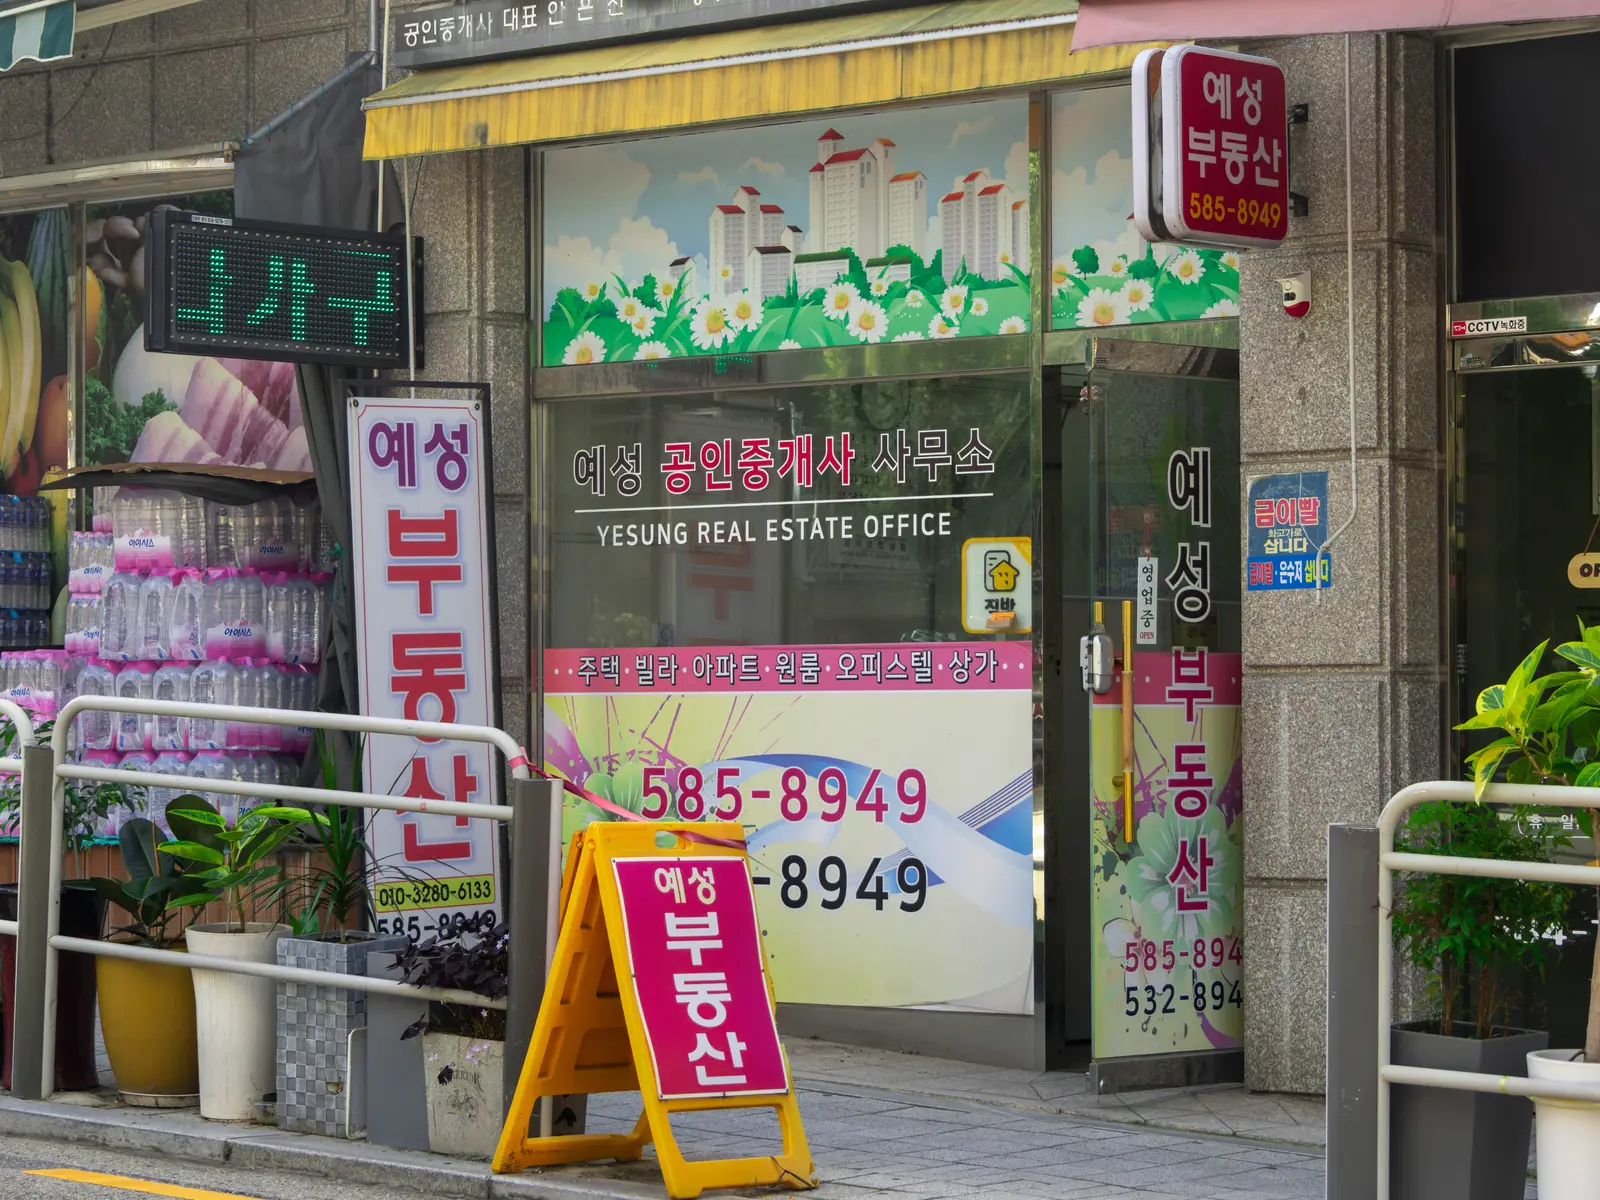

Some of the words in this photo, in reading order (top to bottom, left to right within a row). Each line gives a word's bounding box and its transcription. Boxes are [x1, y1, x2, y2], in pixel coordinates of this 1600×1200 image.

[404, 12, 493, 47] 공인중개사
[503, 5, 537, 31] 대표
[1203, 71, 1263, 126] 예성
[1188, 126, 1282, 188] 부동산
[1189, 192, 1281, 229] 585-8949
[368, 420, 469, 491] 예성
[573, 442, 642, 497] 예성
[660, 431, 856, 495] 공인중개사
[871, 427, 995, 484] 사무소
[597, 521, 688, 547] YESUNG
[698, 519, 757, 545] REAL
[766, 515, 853, 542] ESTATE
[863, 512, 951, 538] OFFICE
[1255, 497, 1320, 528] 금이빨
[1264, 537, 1308, 554] 삽니다
[1140, 564, 1155, 628] 영업중
[1140, 632, 1155, 640] OPEN
[387, 508, 478, 863] 부동산
[577, 654, 621, 686] 주택
[635, 653, 679, 686] 빌라
[692, 652, 761, 685] 아파트
[775, 651, 821, 685] 원룸
[835, 650, 933, 684] 오피스텔
[948, 649, 998, 683] 상가
[640, 766, 928, 824] 585-8949
[1164, 645, 1215, 914] 부동산
[379, 880, 492, 906] 010-3280-6133
[654, 867, 717, 905] 예성
[664, 911, 747, 1086] 부동산
